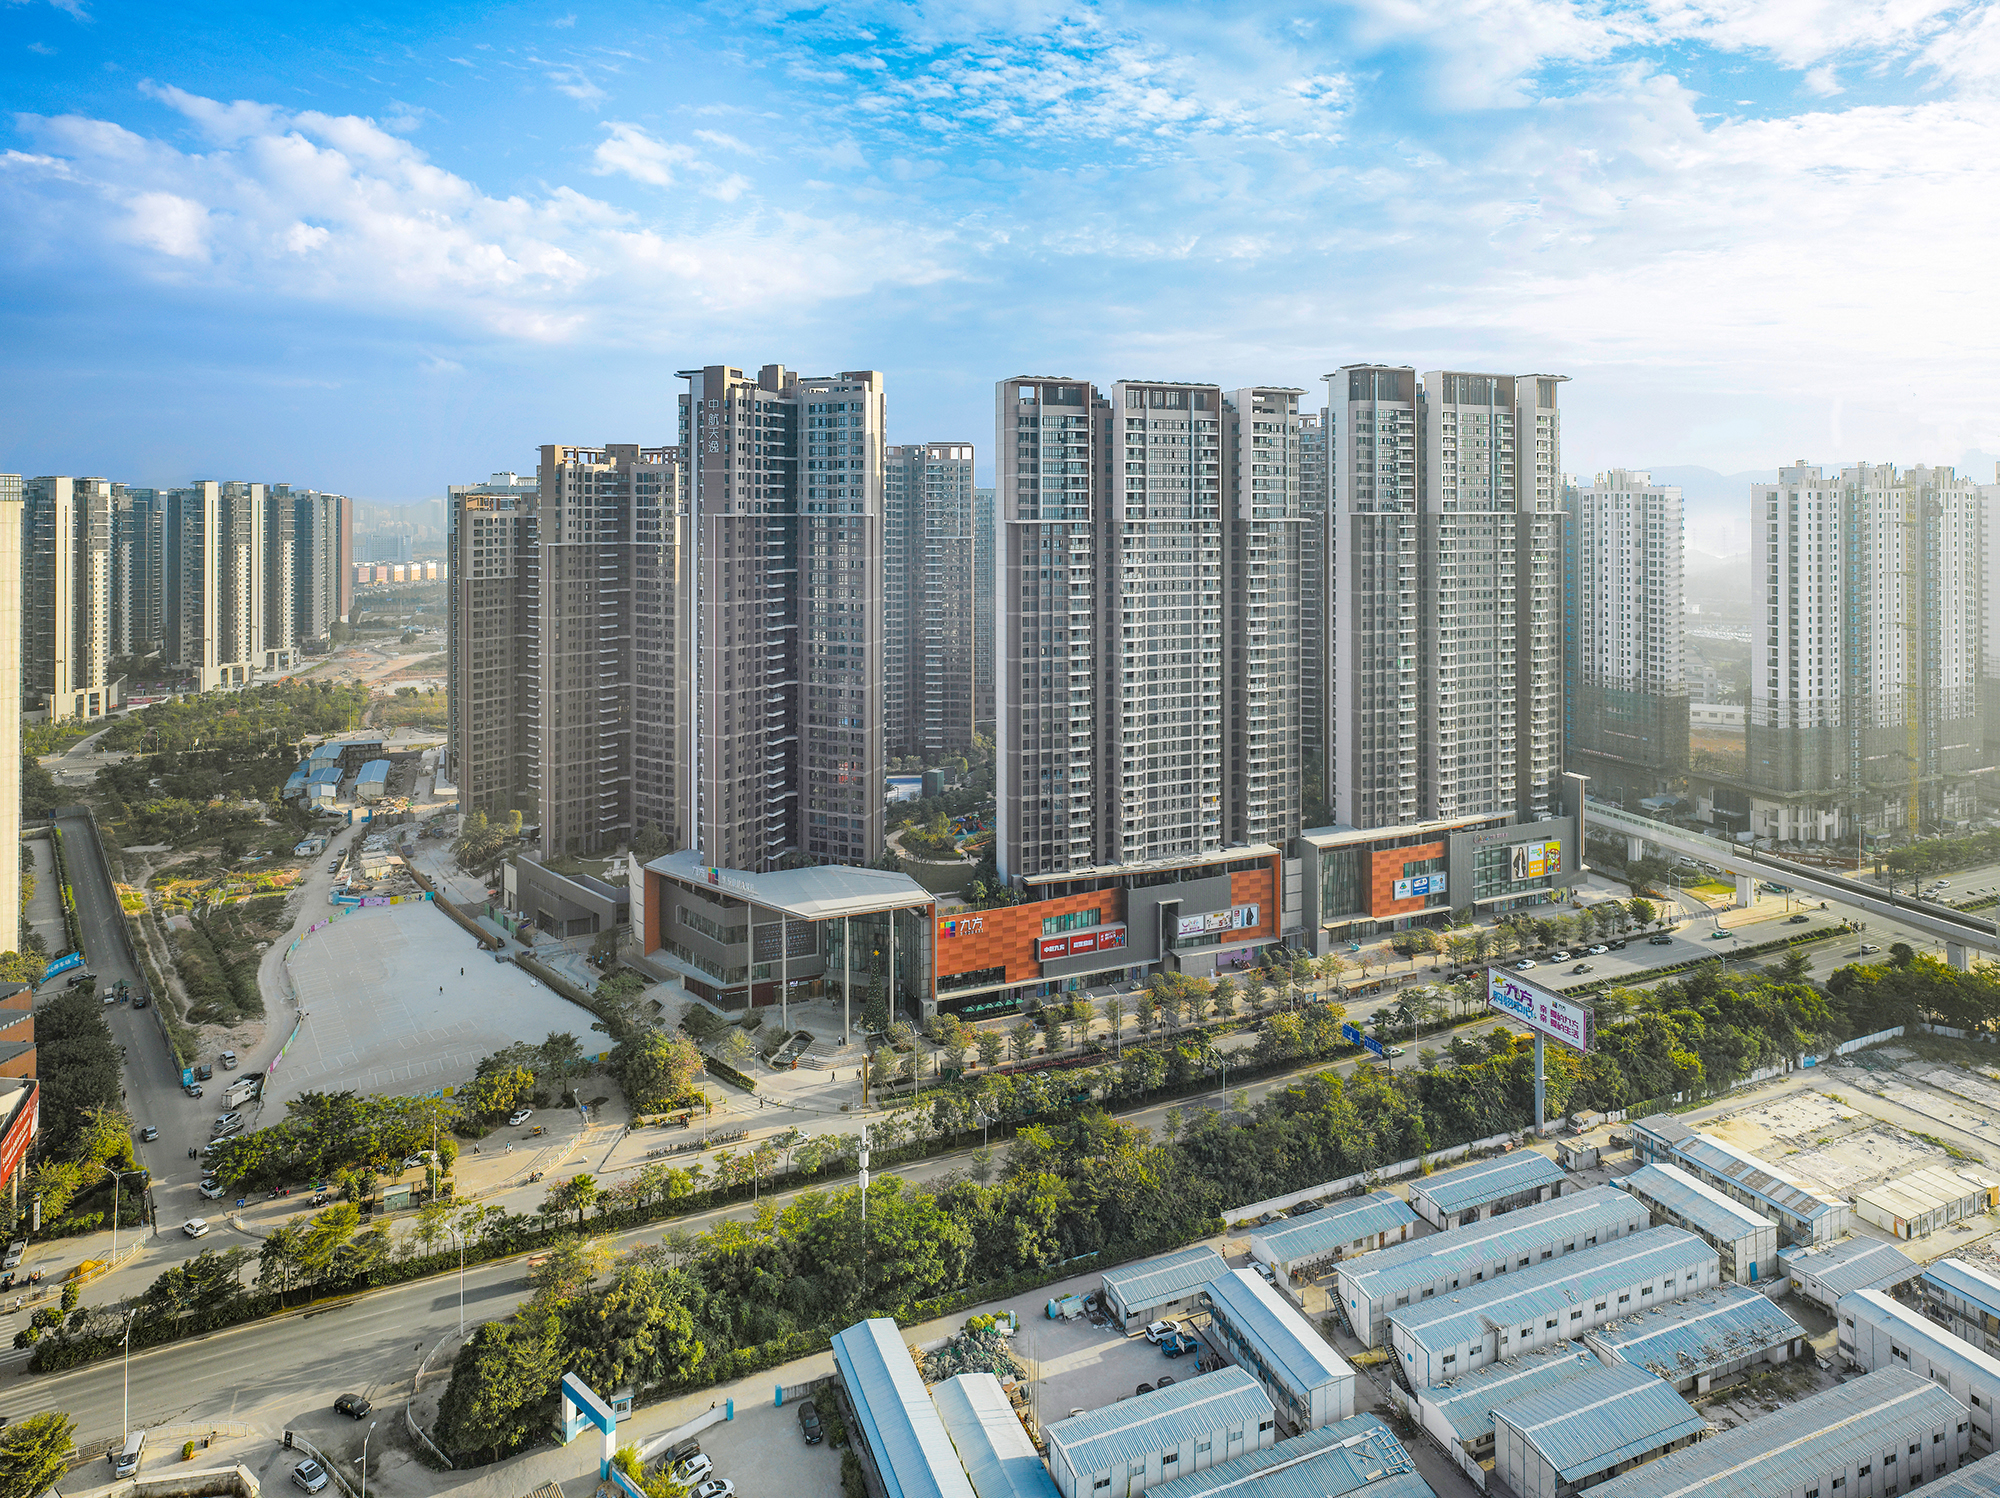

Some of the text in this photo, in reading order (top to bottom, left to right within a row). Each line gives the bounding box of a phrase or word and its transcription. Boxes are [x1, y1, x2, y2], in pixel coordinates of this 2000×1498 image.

[707, 398, 719, 454] 中航天逸
[960, 917, 983, 931] 九方
[1493, 990, 1534, 1020] 购物中心
[1505, 983, 1533, 1008] 九方
